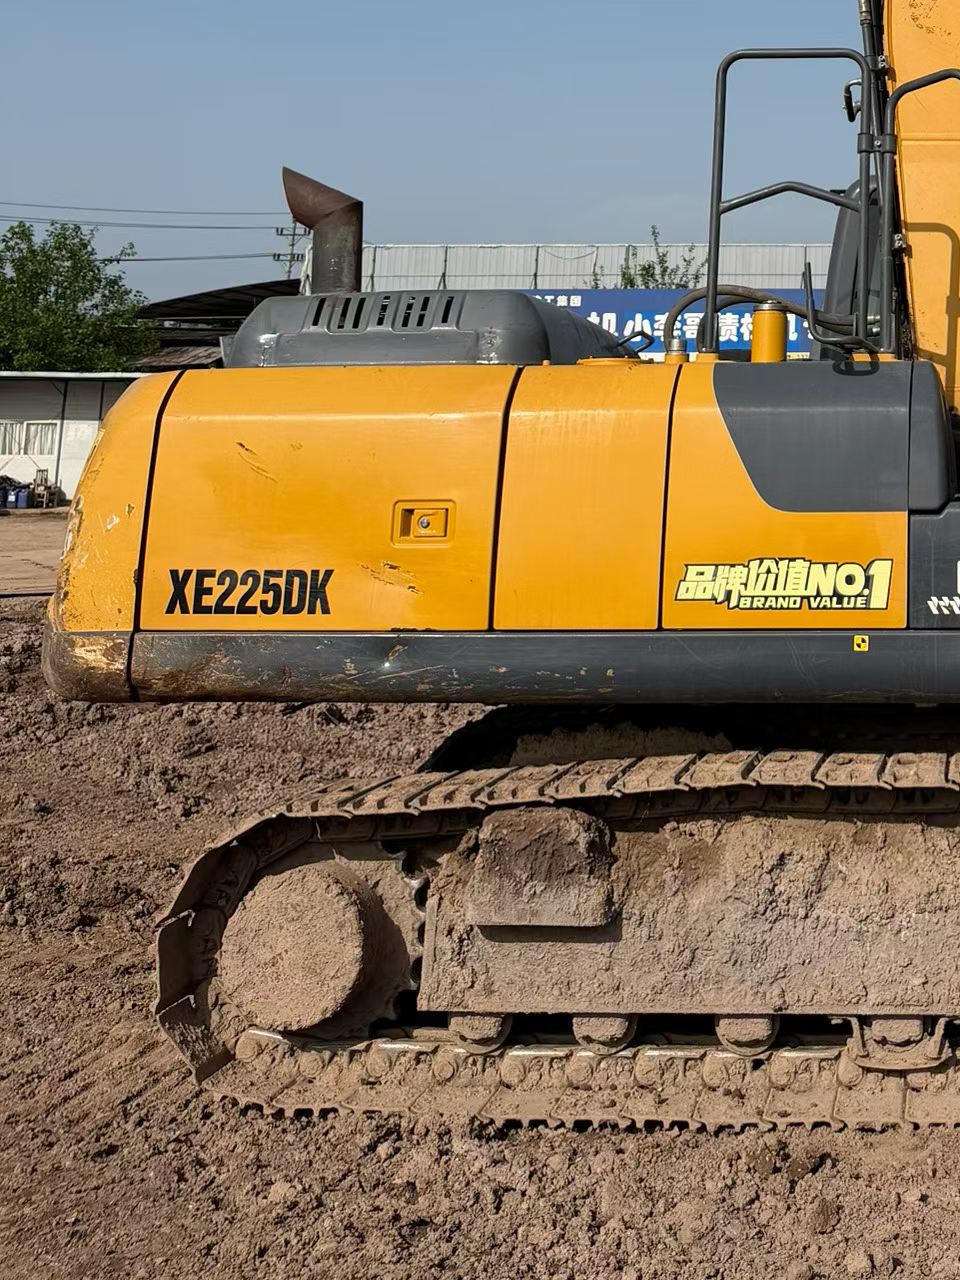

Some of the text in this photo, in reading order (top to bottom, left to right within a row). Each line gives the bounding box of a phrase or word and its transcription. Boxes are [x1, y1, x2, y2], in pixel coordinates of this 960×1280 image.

[165, 568, 335, 615] XE225DK
[738, 596, 868, 609] BRAND VALUE
